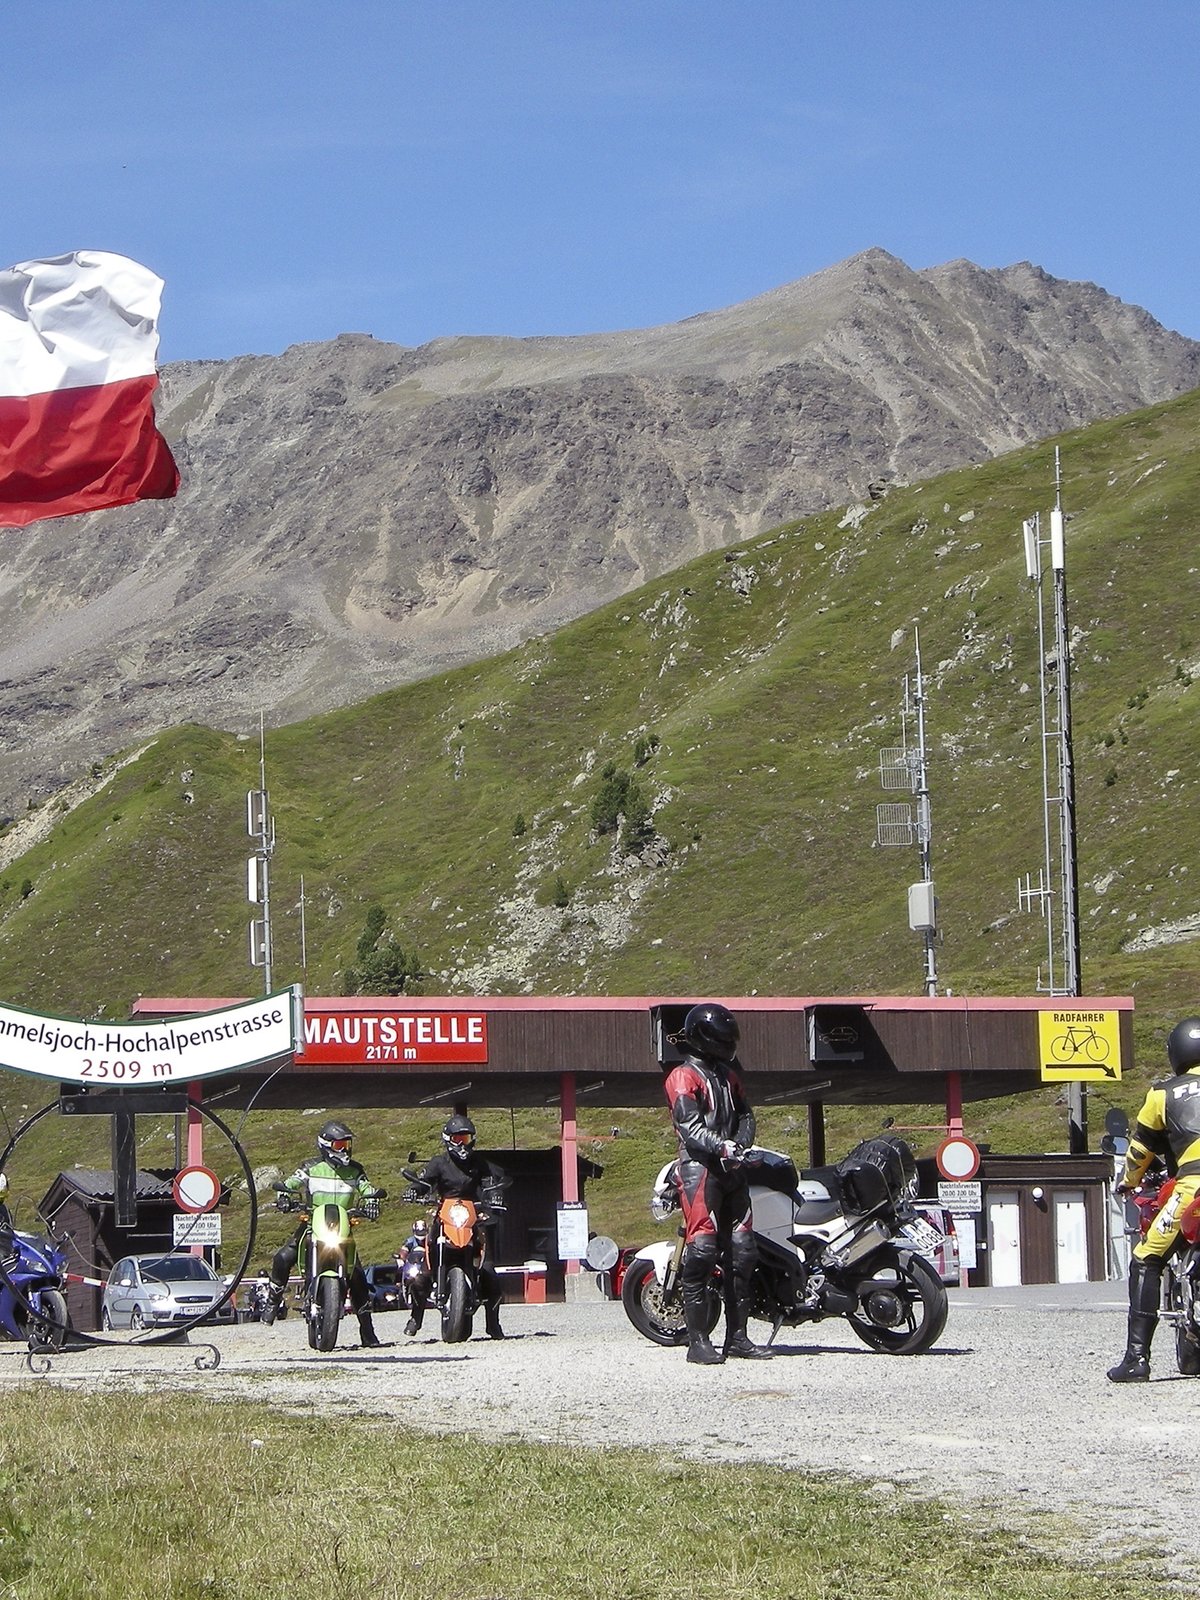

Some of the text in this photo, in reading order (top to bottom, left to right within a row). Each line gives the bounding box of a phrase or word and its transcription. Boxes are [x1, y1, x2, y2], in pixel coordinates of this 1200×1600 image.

[1053, 1012, 1105, 1023] RADFAHRER
[304, 1017, 483, 1044] MAUTSTELLE
[366, 1046, 417, 1059] 2171 m
[80, 1059, 173, 1079] 2509 m
